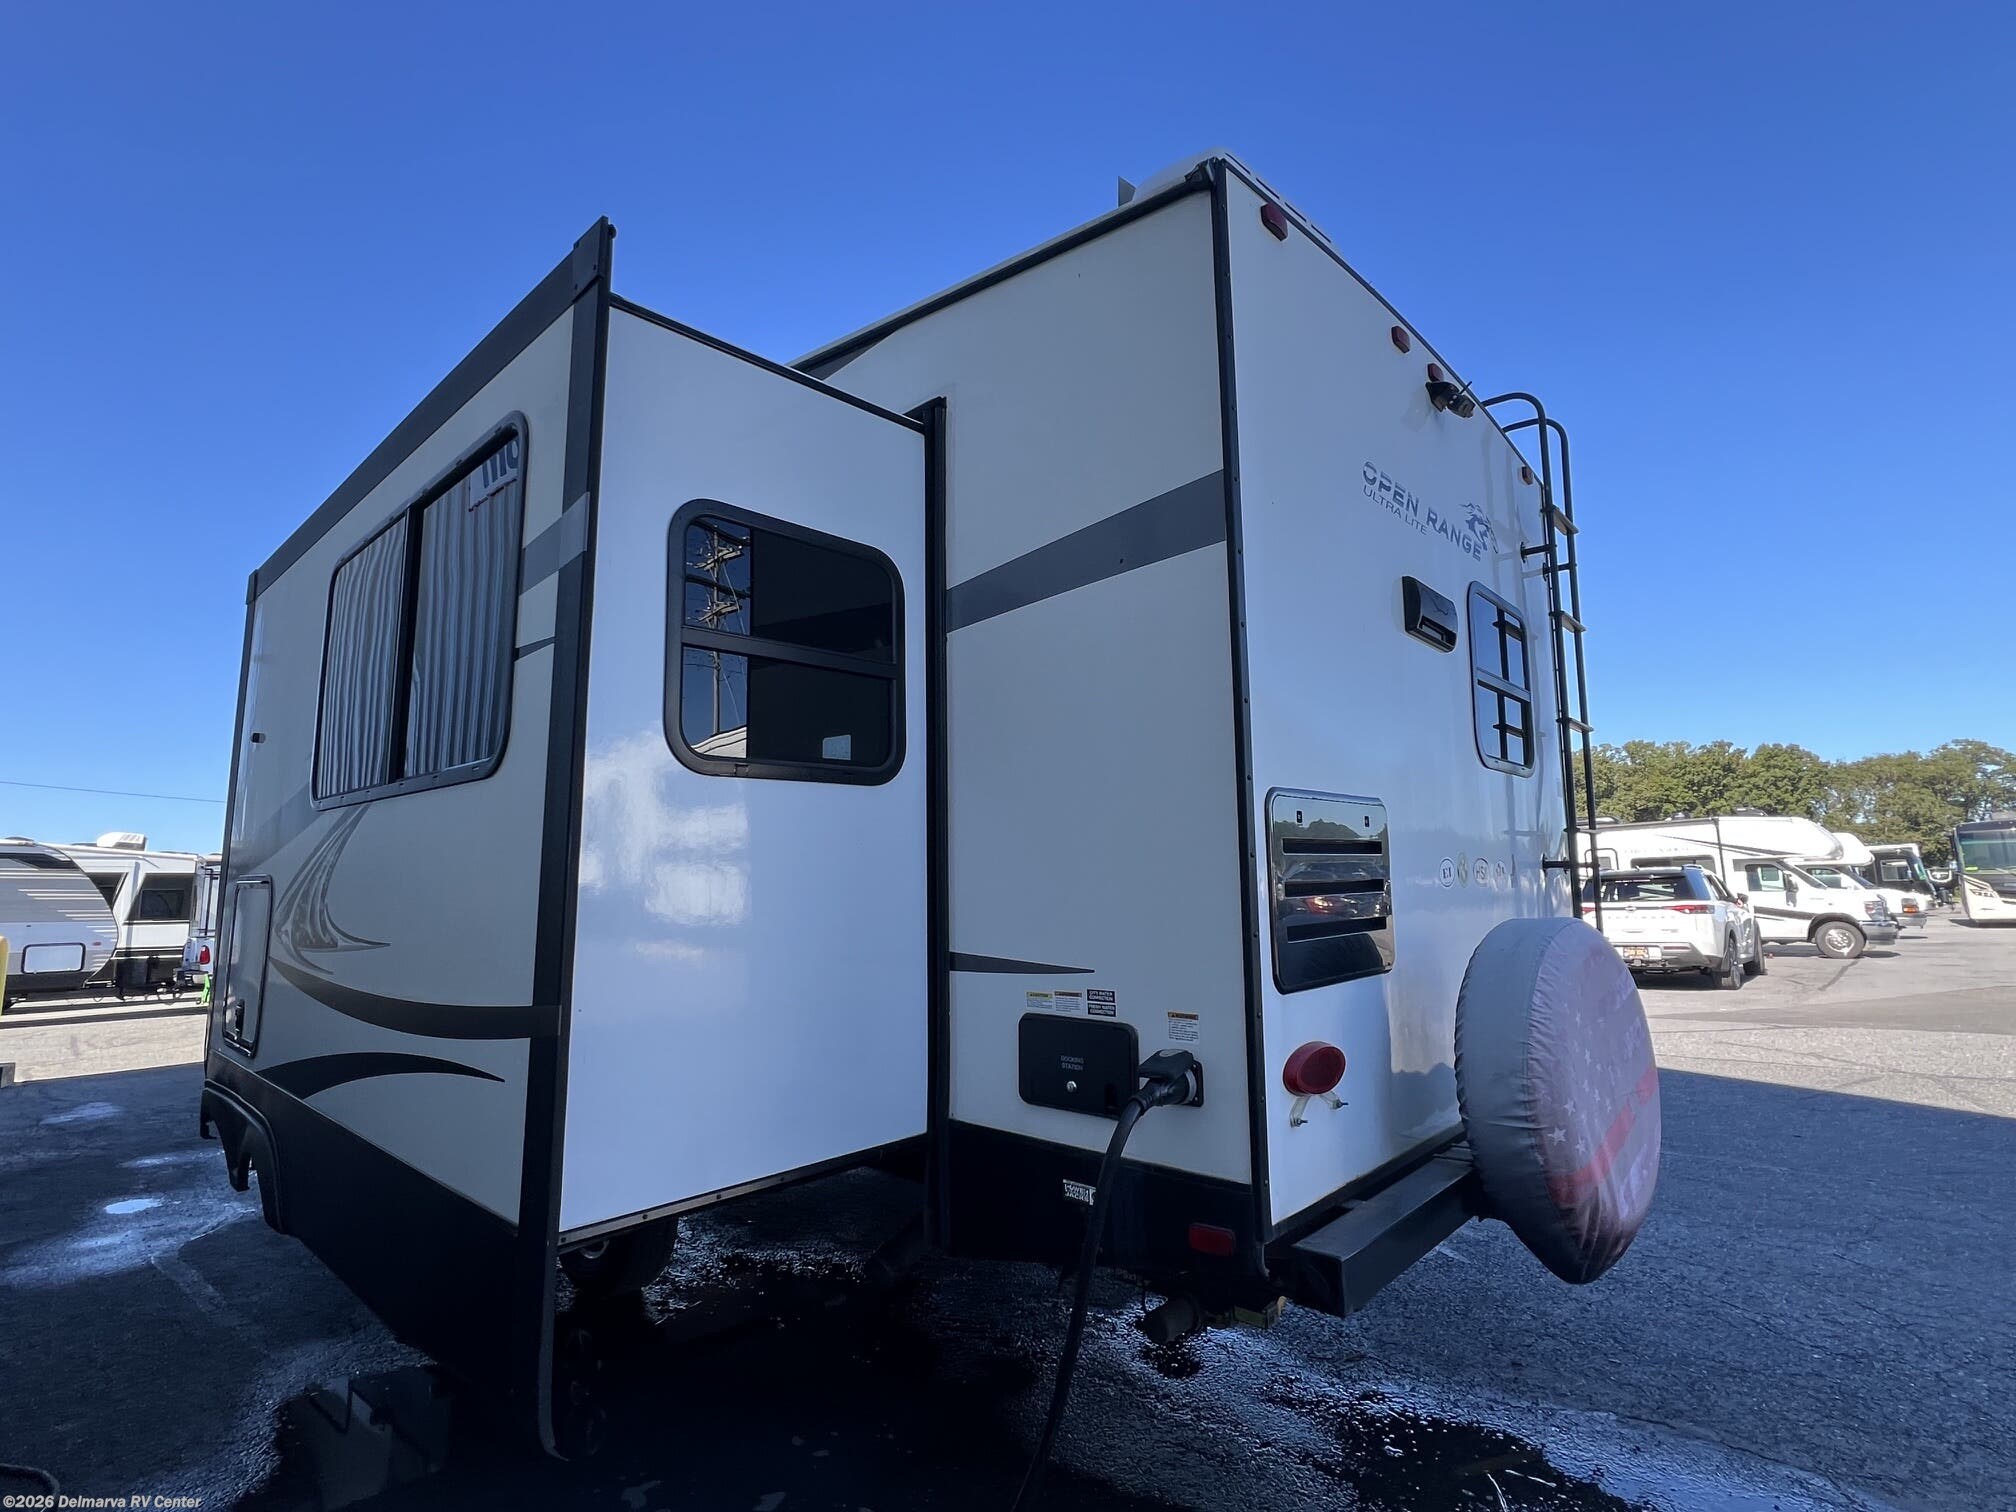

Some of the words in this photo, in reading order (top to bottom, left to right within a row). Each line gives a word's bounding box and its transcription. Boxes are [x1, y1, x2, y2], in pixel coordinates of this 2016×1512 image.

[1362, 461, 1420, 517] OPEN
[1425, 507, 1483, 562] RANGE
[1363, 484, 1402, 519] ULTRA
[1404, 514, 1428, 536] LITE
